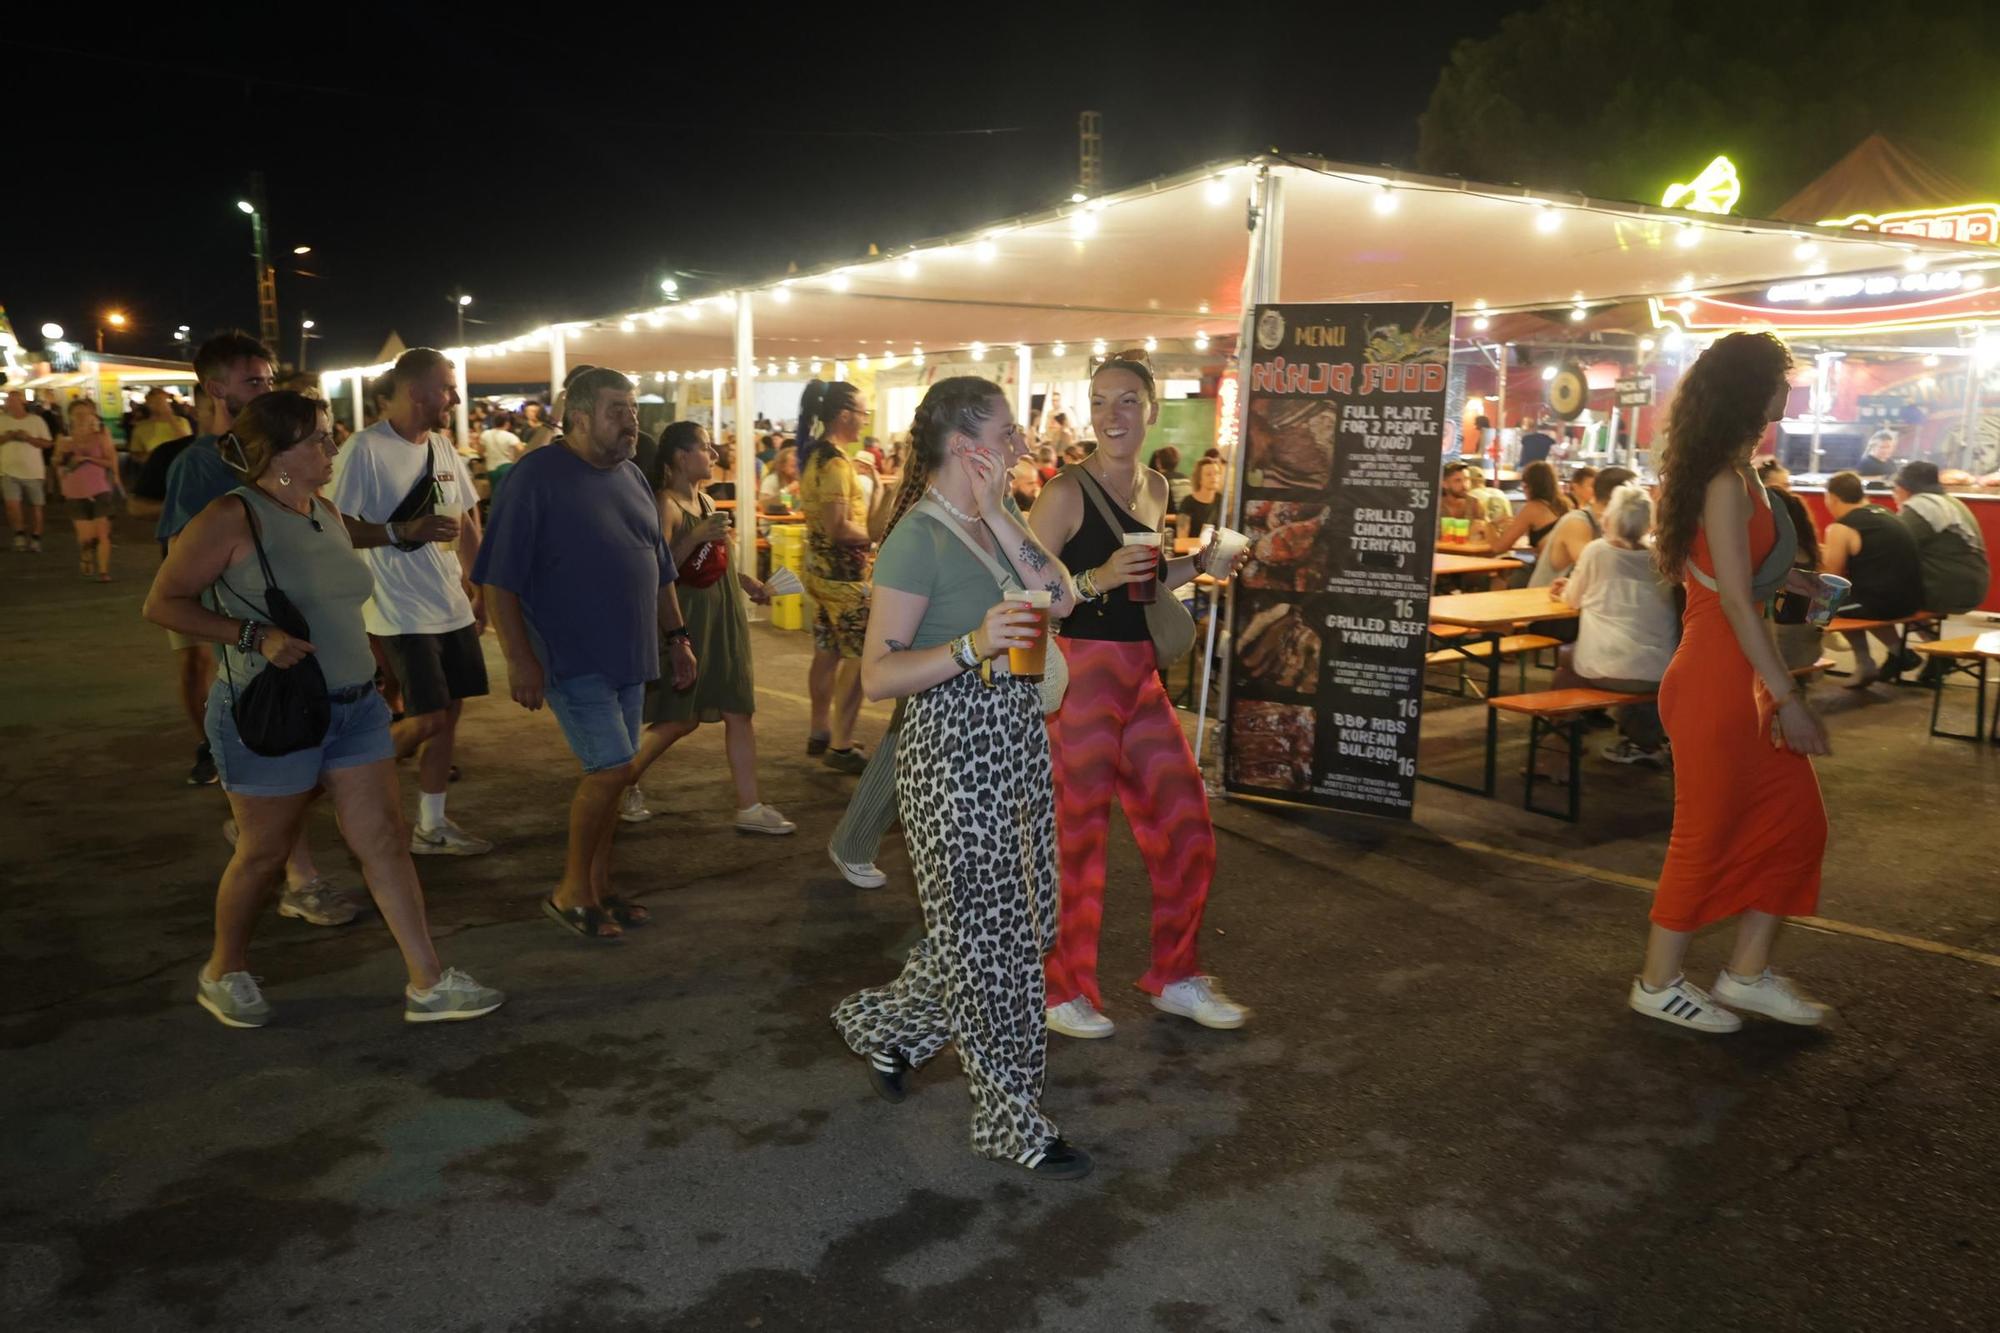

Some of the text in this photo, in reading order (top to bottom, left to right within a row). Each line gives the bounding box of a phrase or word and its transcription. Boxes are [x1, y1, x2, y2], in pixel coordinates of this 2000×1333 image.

[1295, 326, 1346, 347] MENU
[1359, 363, 1446, 395] FOOD
[1343, 405, 1433, 420] FULL PLATE
[1340, 420, 1439, 436] FOR 2 PEOPLE
[1408, 489, 1431, 509] 35
[1353, 507, 1416, 524] GRILLED
[1353, 522, 1414, 539] CHICKEN
[1350, 536, 1416, 554] TERIYAKI
[1395, 599, 1414, 618] 16
[1326, 614, 1426, 635] GRILLED BEEF
[1341, 631, 1409, 648] YAKINIKU
[1398, 698, 1418, 718] 16
[1333, 712, 1407, 734] BBQ RIBS
[1340, 728, 1397, 747] KOREAN
[1338, 741, 1398, 762] BULGOGI
[1397, 757, 1416, 777] 16
